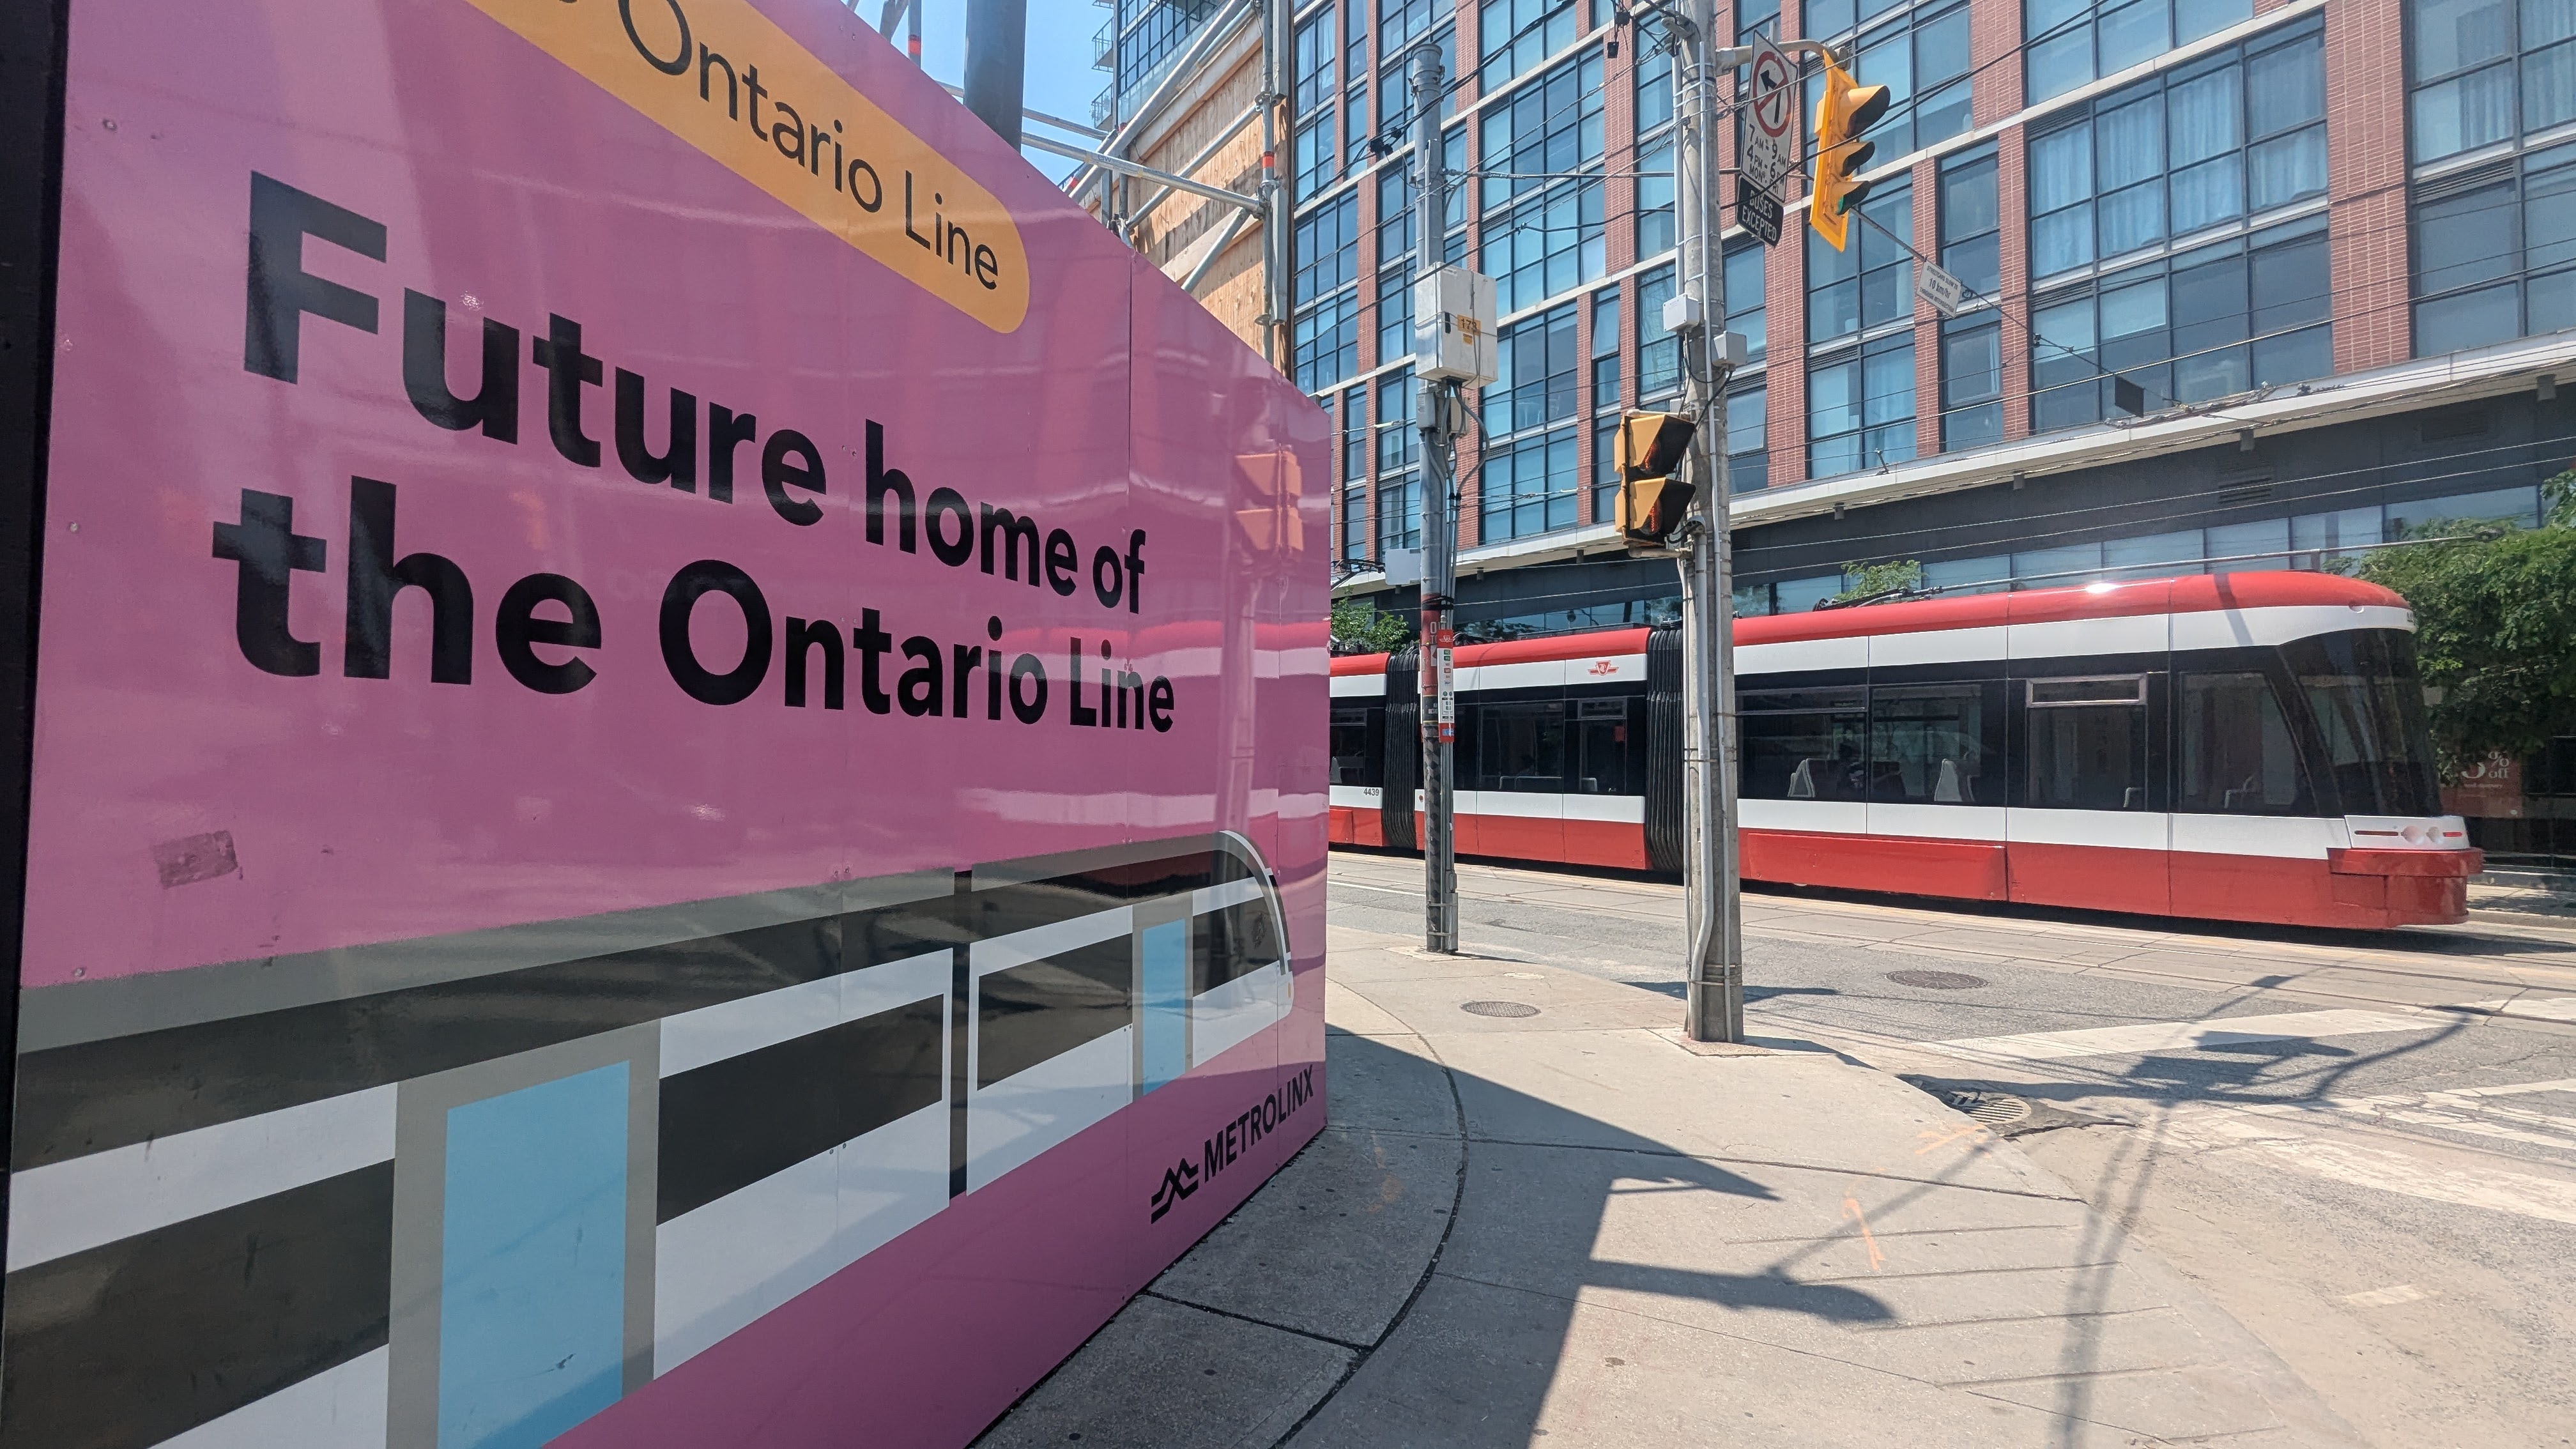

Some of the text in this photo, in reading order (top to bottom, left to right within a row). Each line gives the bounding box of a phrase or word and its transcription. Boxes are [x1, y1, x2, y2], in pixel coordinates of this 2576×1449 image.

[618, 0, 998, 290] Ontario Line
[1742, 204, 1777, 241] EXCEPTED
[1749, 190, 1773, 219] BUSES
[1929, 278, 1936, 289] 10
[245, 171, 1146, 615] Future home of
[212, 475, 1174, 733] the Ontario Line
[1363, 788, 1379, 796] 4439
[2488, 768, 2510, 779] off
[1204, 1064, 1314, 1183] METROLINX
